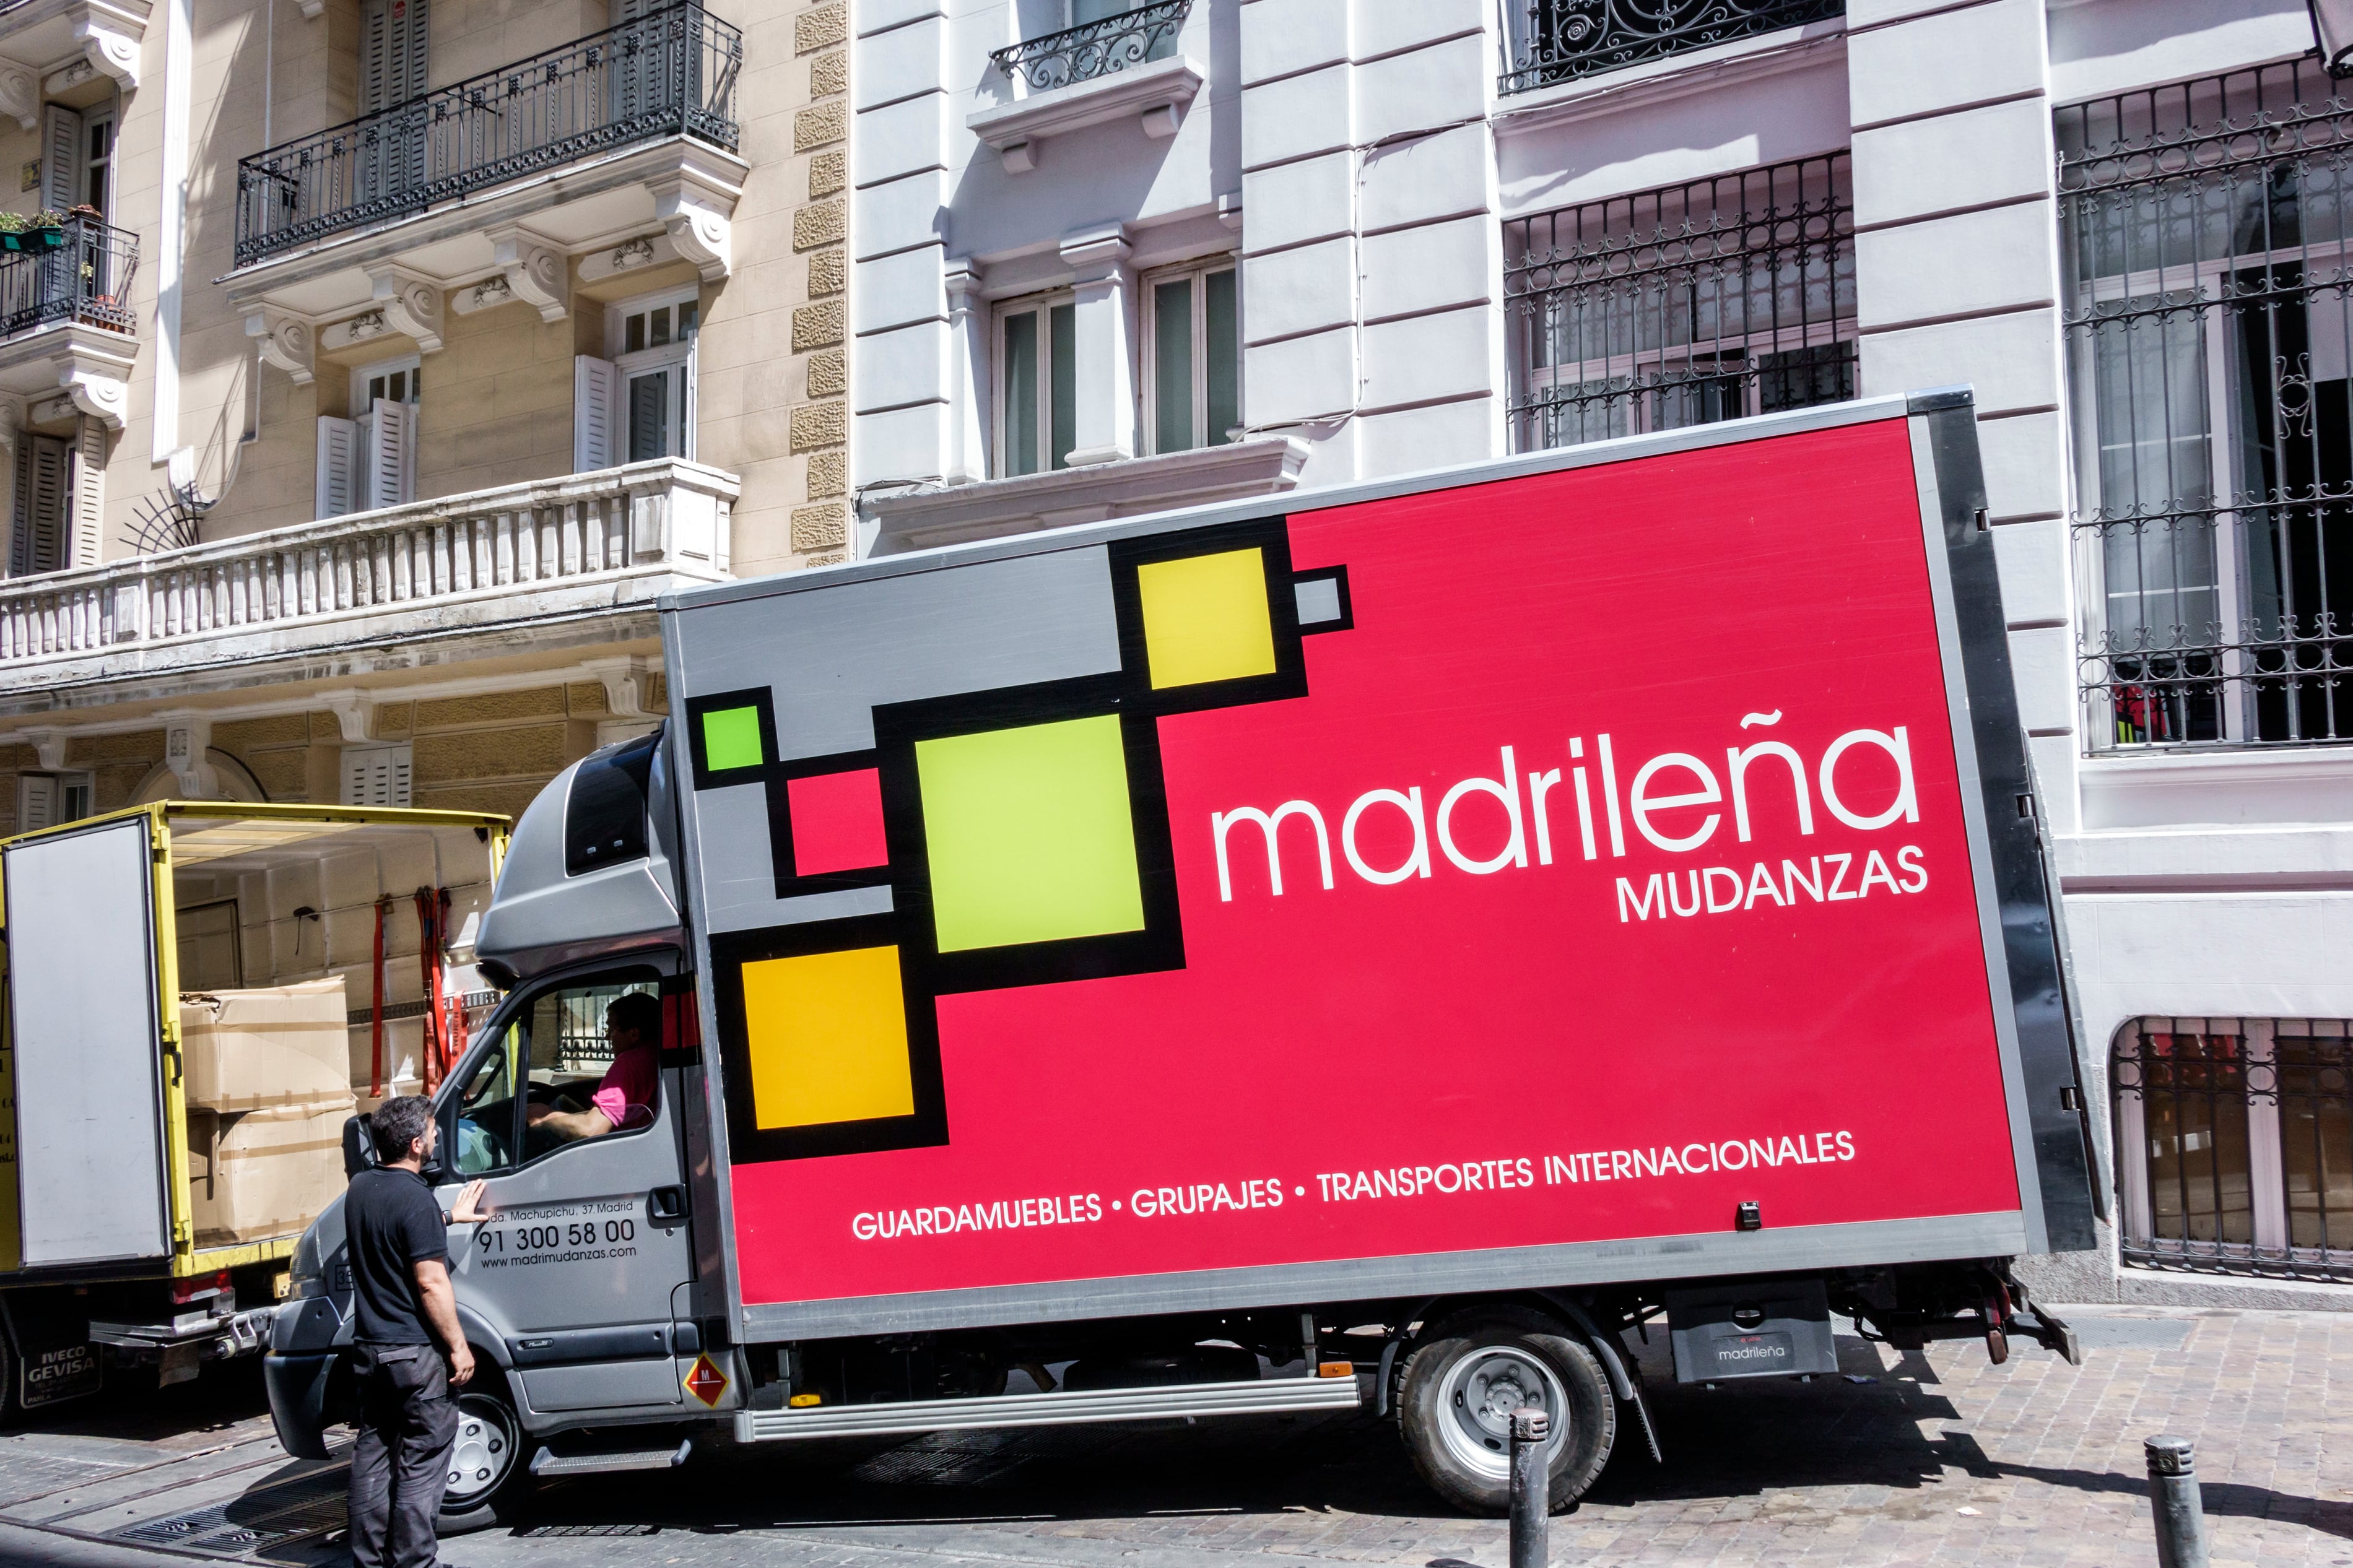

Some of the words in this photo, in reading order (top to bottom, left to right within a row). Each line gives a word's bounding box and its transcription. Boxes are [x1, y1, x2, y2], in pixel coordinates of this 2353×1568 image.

[1211, 708, 1920, 902] madrileña
[1616, 846, 1928, 923] MUDANZAS
[852, 1193, 1102, 1240] GUARDAMUEBLES
[1131, 1179, 1284, 1218] GRUPAJES
[1316, 1158, 1534, 1202] TRANSPORTES
[1544, 1131, 1855, 1185] INTERNACIONALES
[511, 1206, 578, 1220] Machupichu,
[597, 1201, 633, 1213] Madrid
[479, 1231, 503, 1254] 91
[516, 1225, 559, 1250] 300
[568, 1222, 596, 1245] 58
[605, 1218, 635, 1242] 00
[481, 1257, 508, 1268] www
[511, 1247, 637, 1267] madrimudanzas.com
[41, 1346, 86, 1364] IVECO
[1719, 1345, 1785, 1360] madrileña
[28, 1357, 95, 1382] GEVISA
[701, 1369, 710, 1380] M
